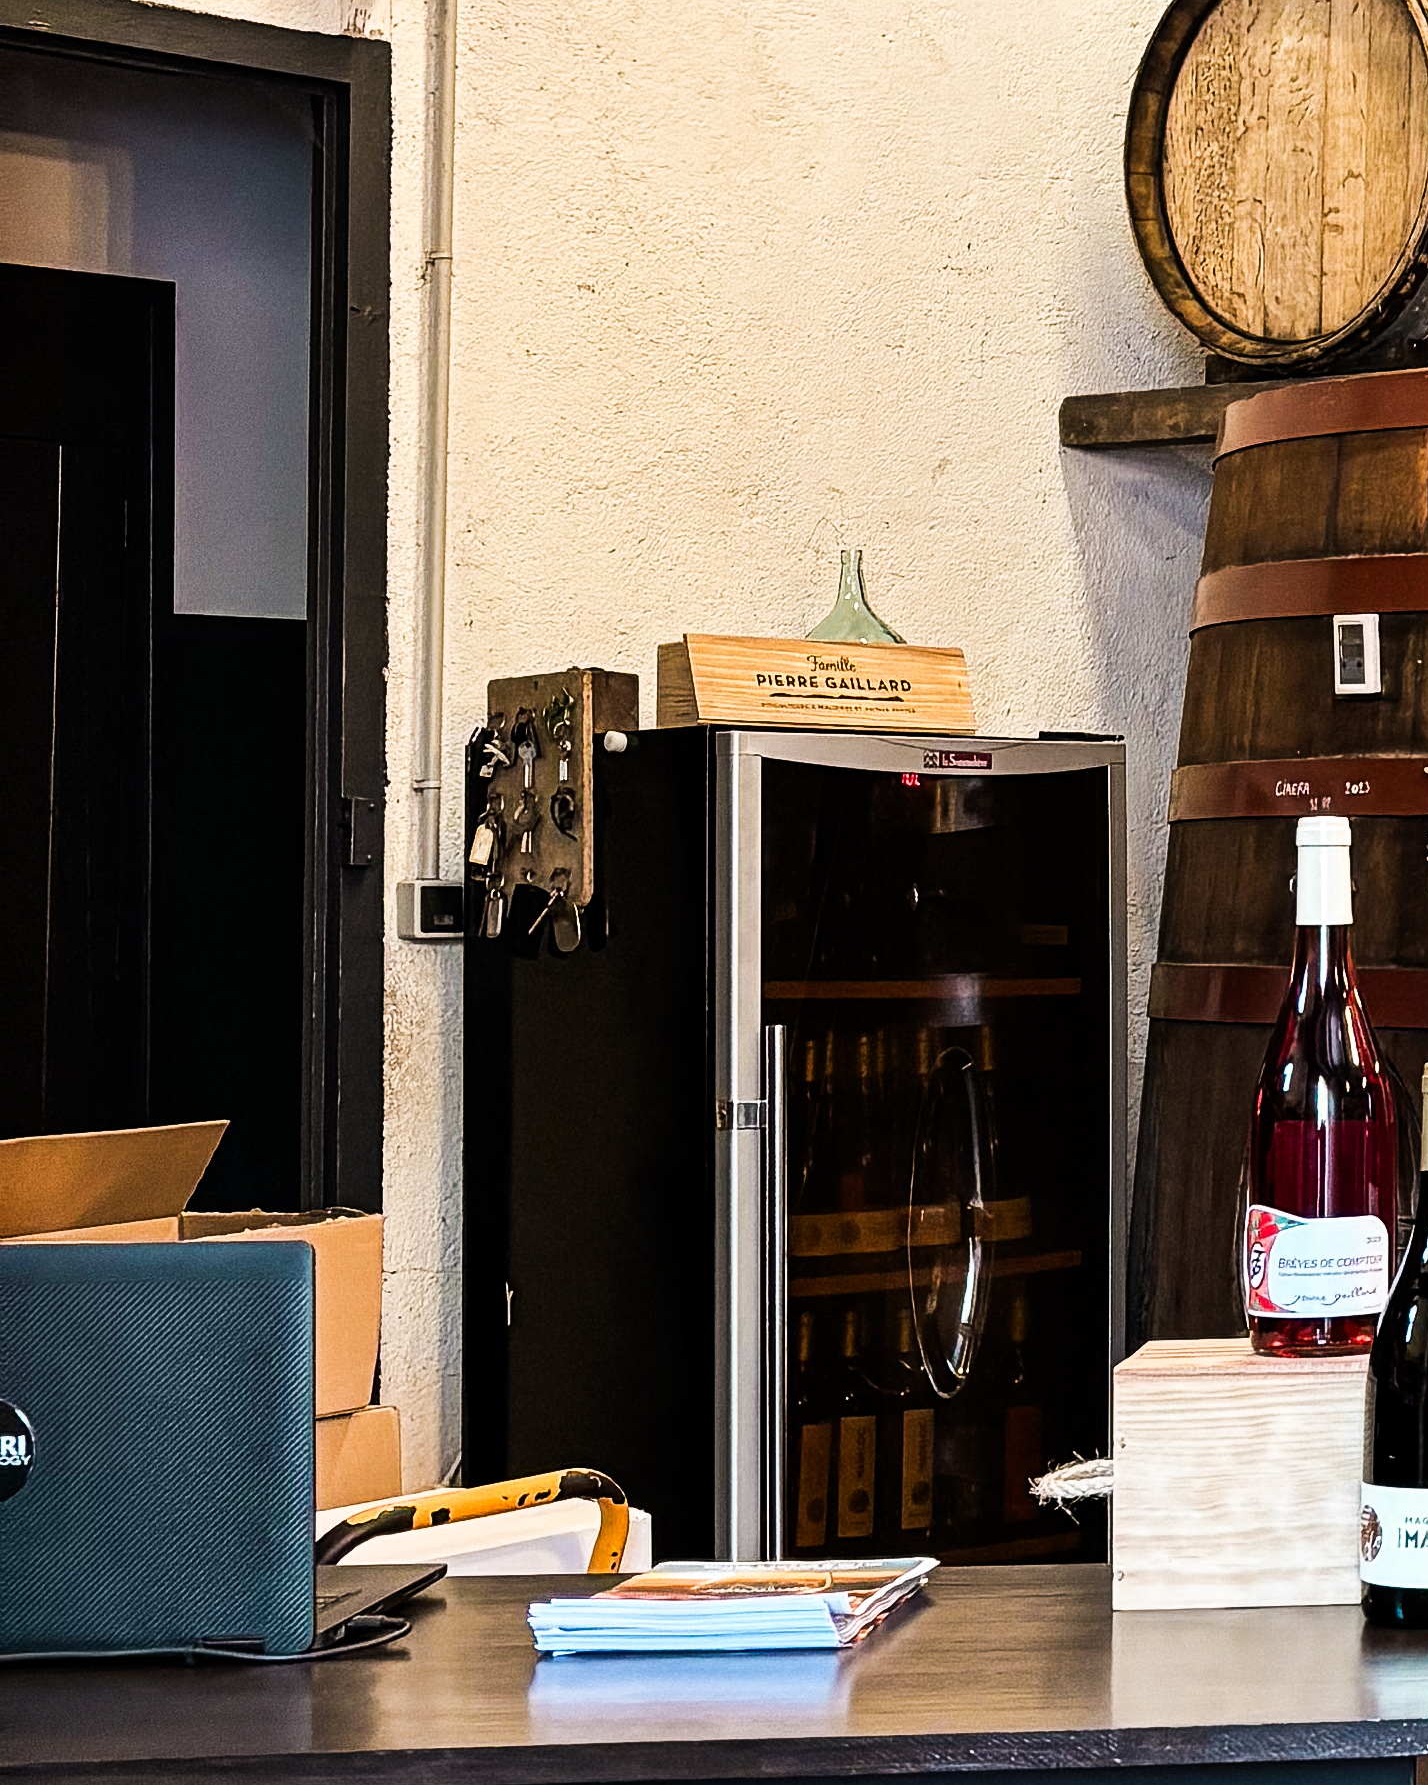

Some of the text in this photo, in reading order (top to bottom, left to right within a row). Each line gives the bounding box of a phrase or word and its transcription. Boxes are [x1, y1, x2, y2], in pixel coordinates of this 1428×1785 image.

[806, 654, 857, 672] Famille
[756, 673, 912, 692] PIERRE GAILLARD
[1320, 1258, 1334, 1268] DE
